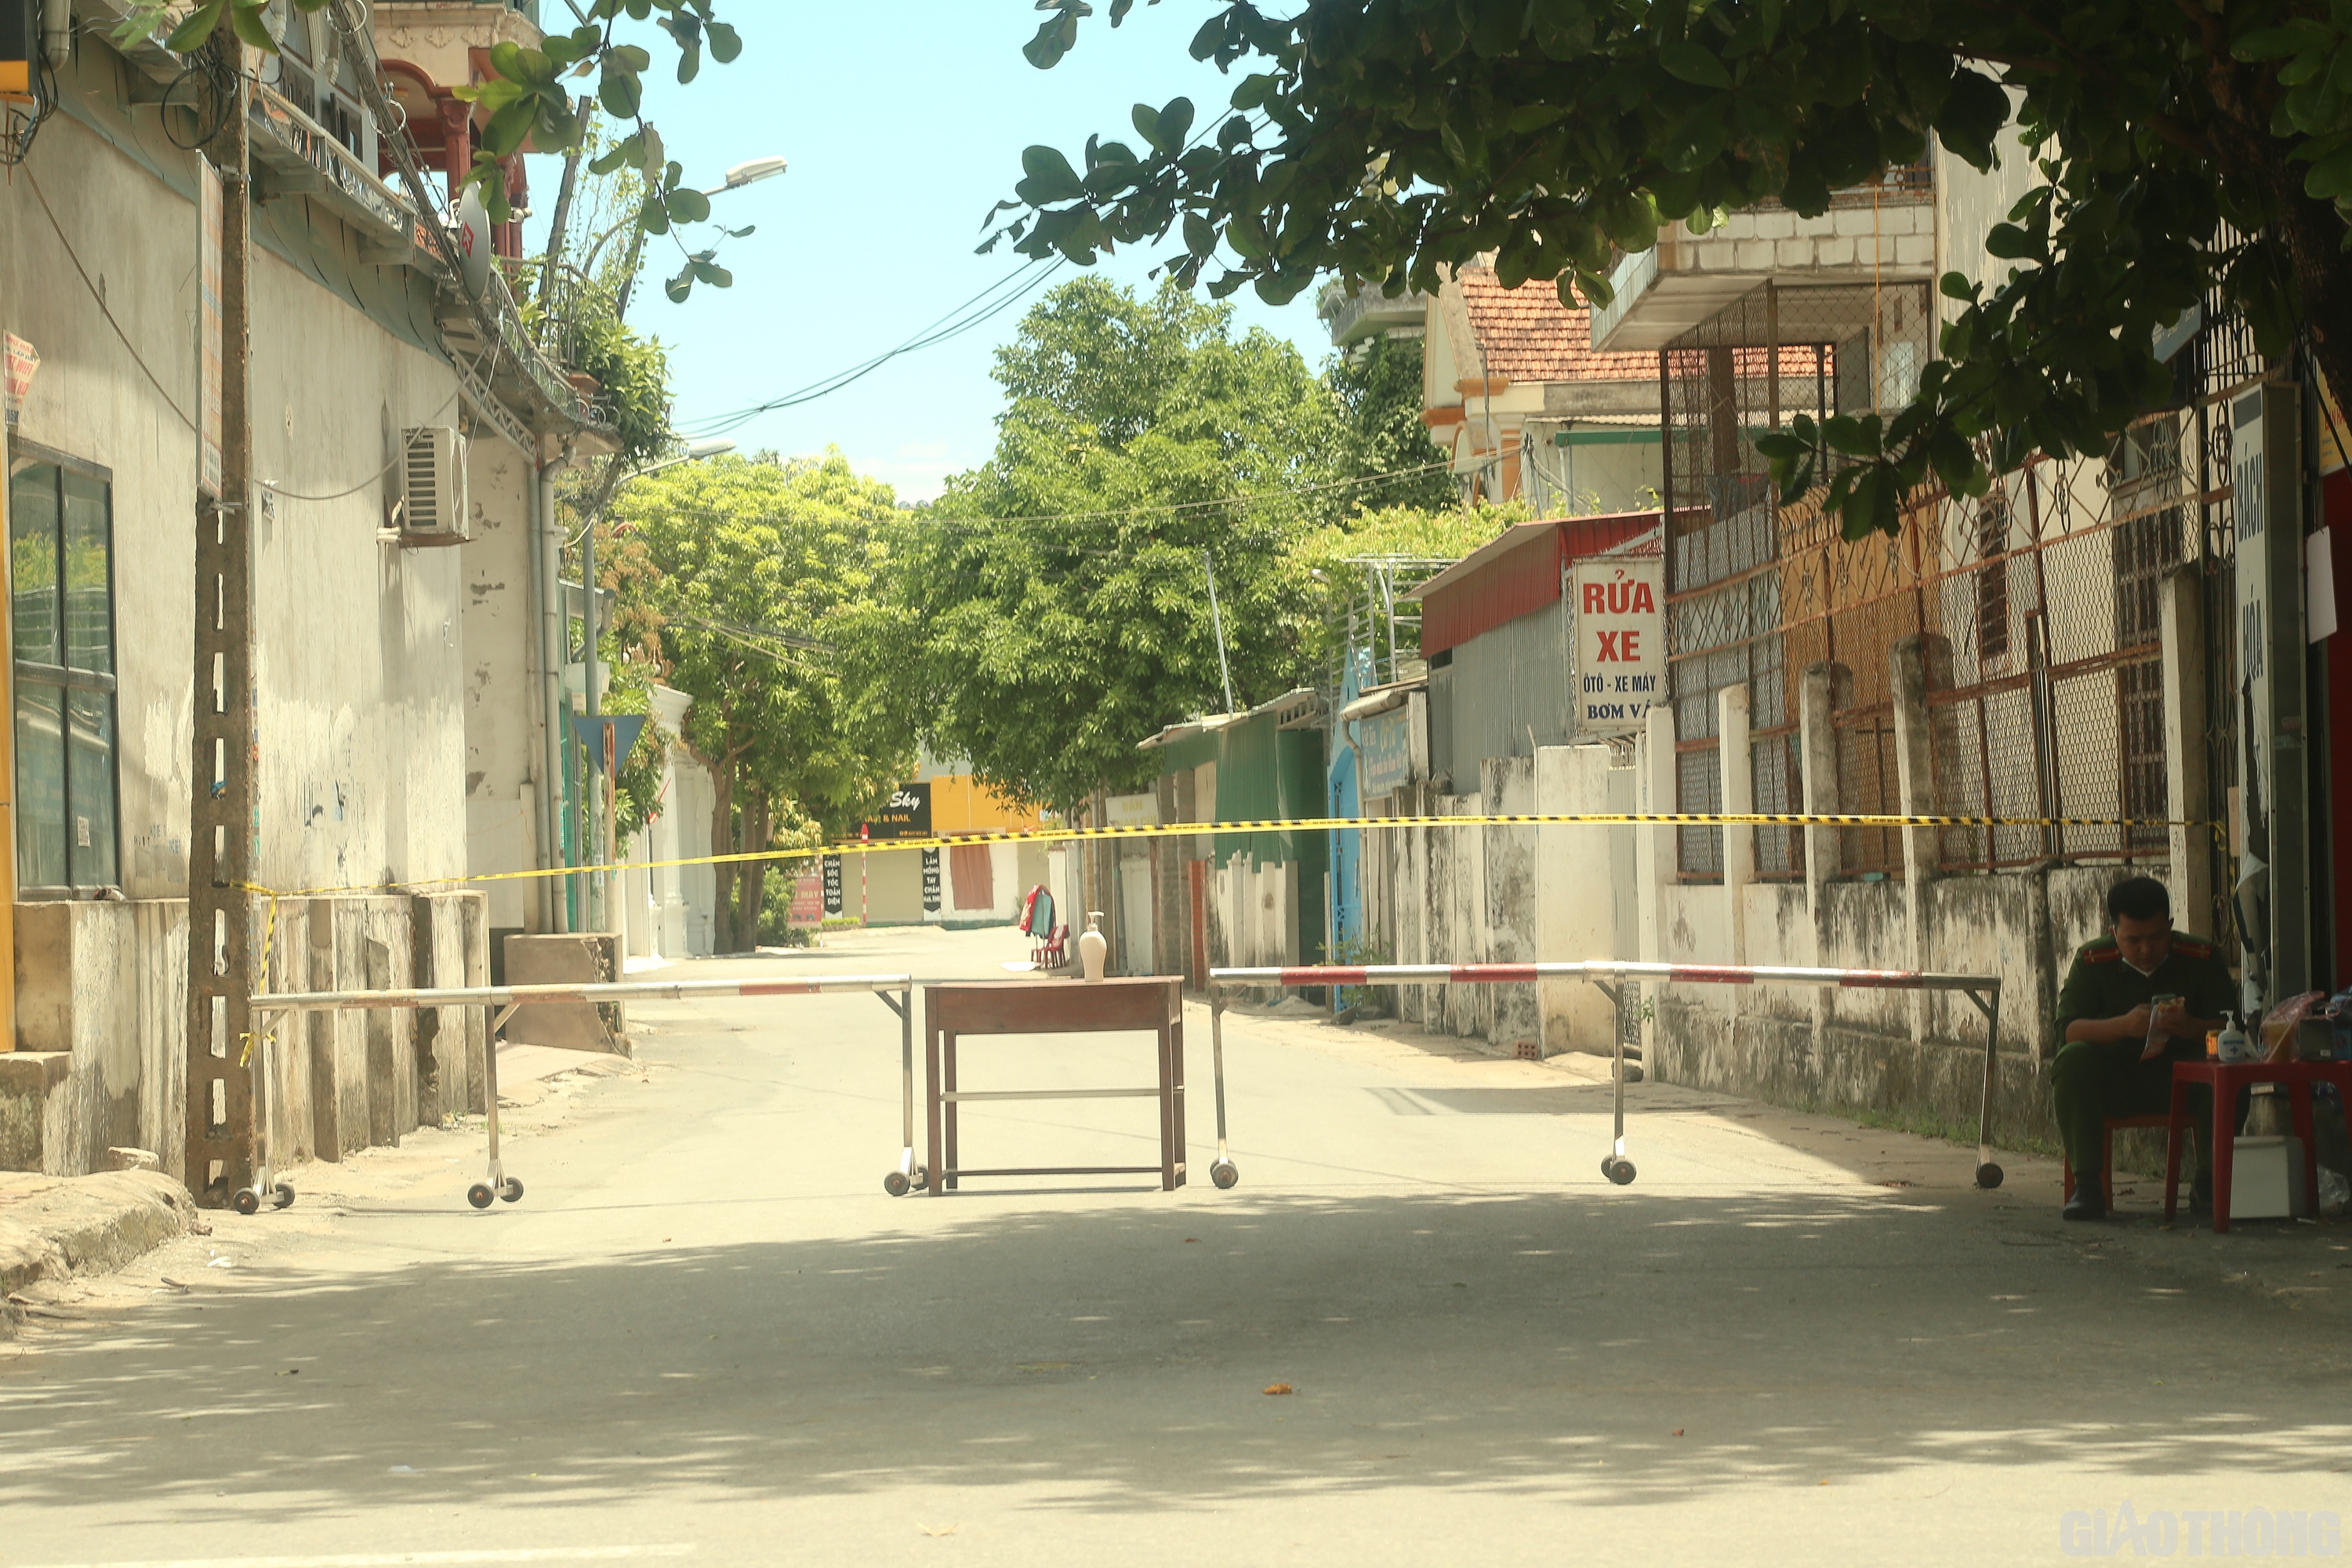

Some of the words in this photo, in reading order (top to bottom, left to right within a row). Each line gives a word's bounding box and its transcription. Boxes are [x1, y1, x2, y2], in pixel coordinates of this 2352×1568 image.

[2237, 441, 2263, 543] BÁCH
[1583, 569, 1655, 614] RỬA
[2242, 583, 2263, 681] HÓA
[1596, 630, 1641, 662] XE
[1584, 672, 1603, 692] ÔTÔ
[1615, 676, 1628, 692] XE
[1632, 672, 1656, 692] MÁY
[1588, 702, 1624, 719] BƠM
[890, 790, 920, 811] Sky
[891, 814, 910, 822] NAIL
